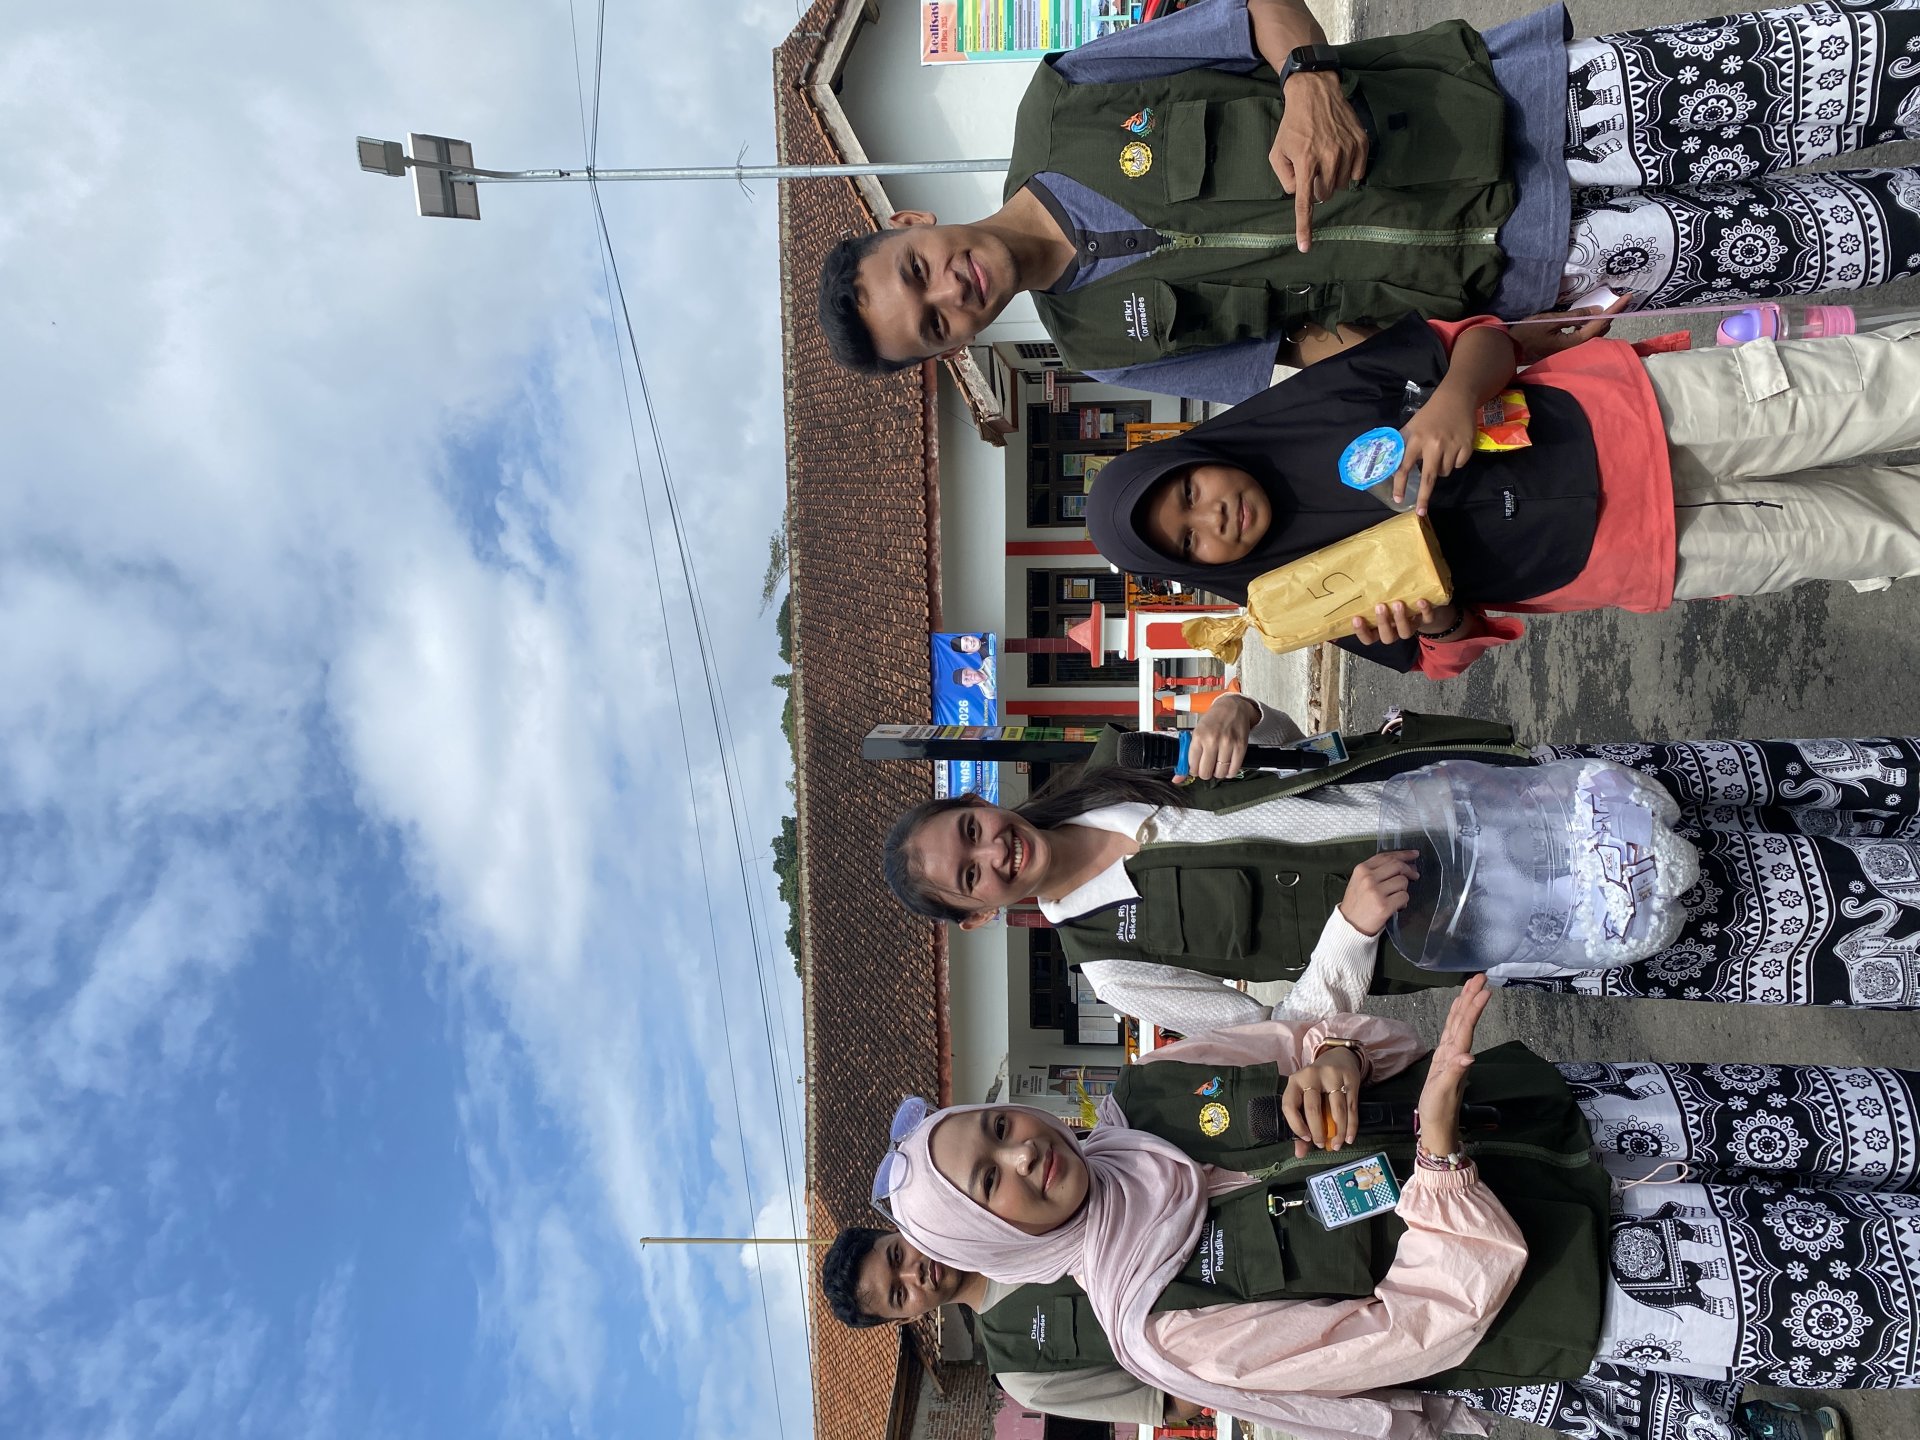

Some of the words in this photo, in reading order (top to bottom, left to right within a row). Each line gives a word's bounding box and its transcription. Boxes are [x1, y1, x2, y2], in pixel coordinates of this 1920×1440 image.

[930, 2, 939, 54] Realisasi
[1123, 300, 1133, 322] Fikri
[1127, 326, 1136, 337] M.
[1306, 572, 1362, 618] 15
[959, 700, 969, 726] 2026
[960, 761, 970, 783] NAS
[1118, 904, 1126, 917] Riy
[1116, 922, 1125, 940] alwa
[1200, 1222, 1210, 1254] Novida
[1214, 1229, 1224, 1272] Pendidikan
[1201, 1258, 1211, 1284] Ages
